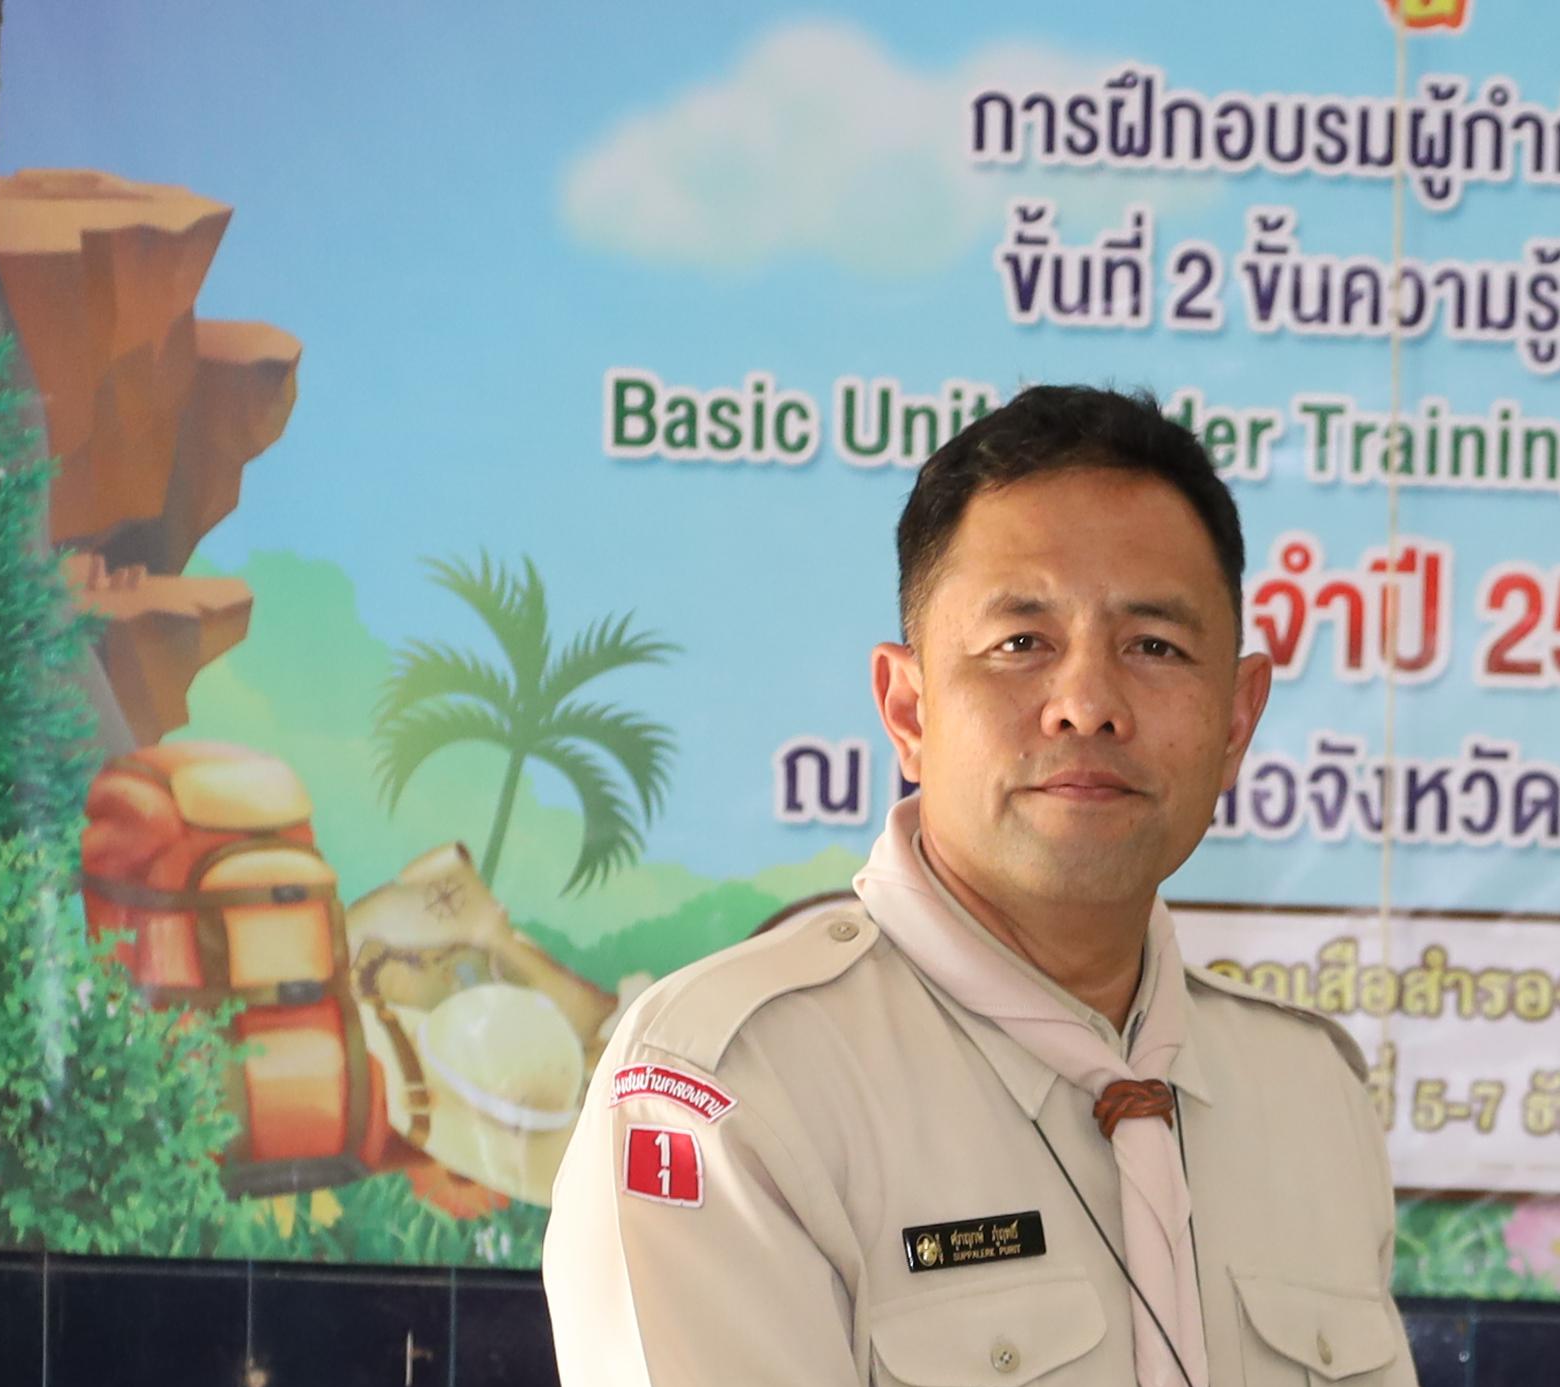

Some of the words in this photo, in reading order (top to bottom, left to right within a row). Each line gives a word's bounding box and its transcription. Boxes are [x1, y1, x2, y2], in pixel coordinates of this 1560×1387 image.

[1004, 206, 1144, 318] ขั้นที่
[1172, 249, 1214, 320] 2
[611, 378, 812, 456] Basic
[1252, 542, 1440, 672] จำปี
[782, 745, 863, 814] ณ
[1411, 1079, 1506, 1135] 5-7
